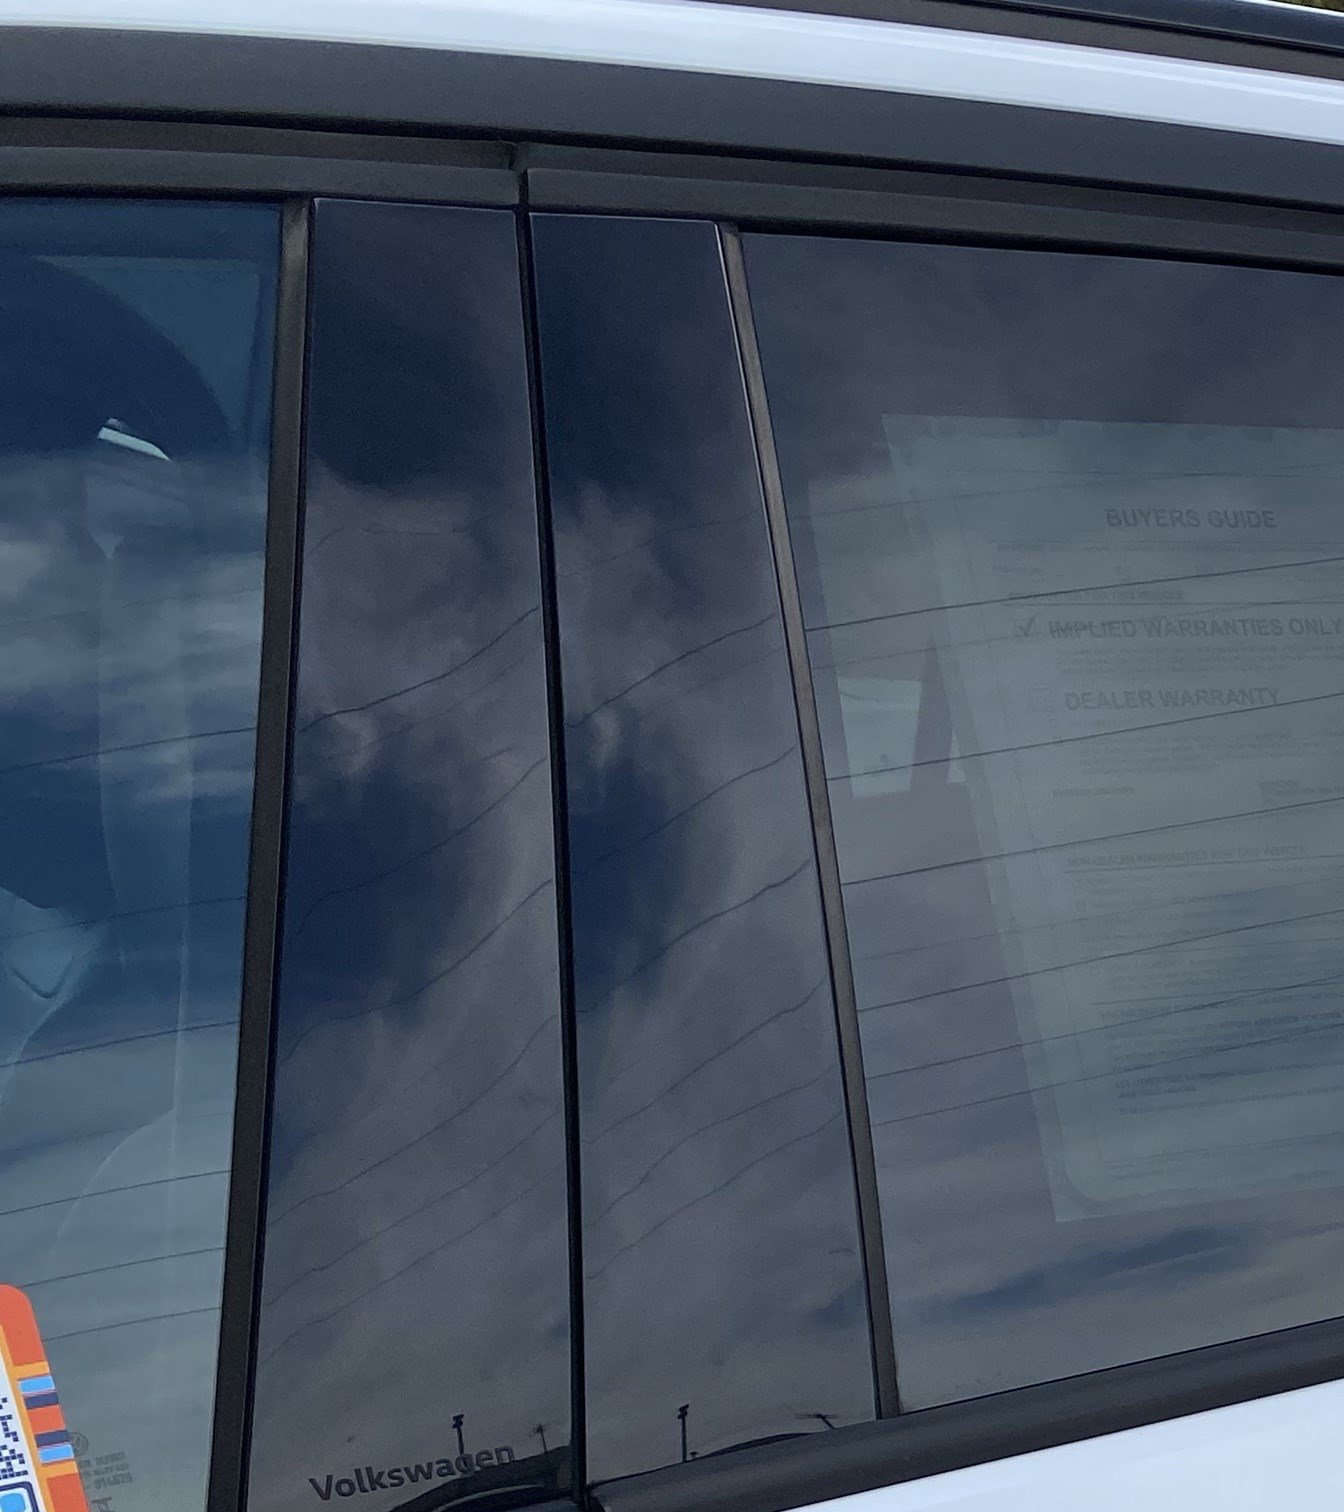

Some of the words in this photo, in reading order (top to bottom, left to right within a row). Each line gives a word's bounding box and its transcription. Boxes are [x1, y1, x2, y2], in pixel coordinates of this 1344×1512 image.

[1105, 508, 1201, 528] BUYERS
[1208, 508, 1278, 529] GUIDE
[1048, 618, 1138, 639] IMPLIED
[1140, 617, 1284, 638] WARRANTIES
[1289, 617, 1344, 636] ONLY
[1065, 689, 1154, 711] DEALER
[1157, 686, 1280, 707] WARRANTY
[309, 1445, 515, 1501] Volkswagen
